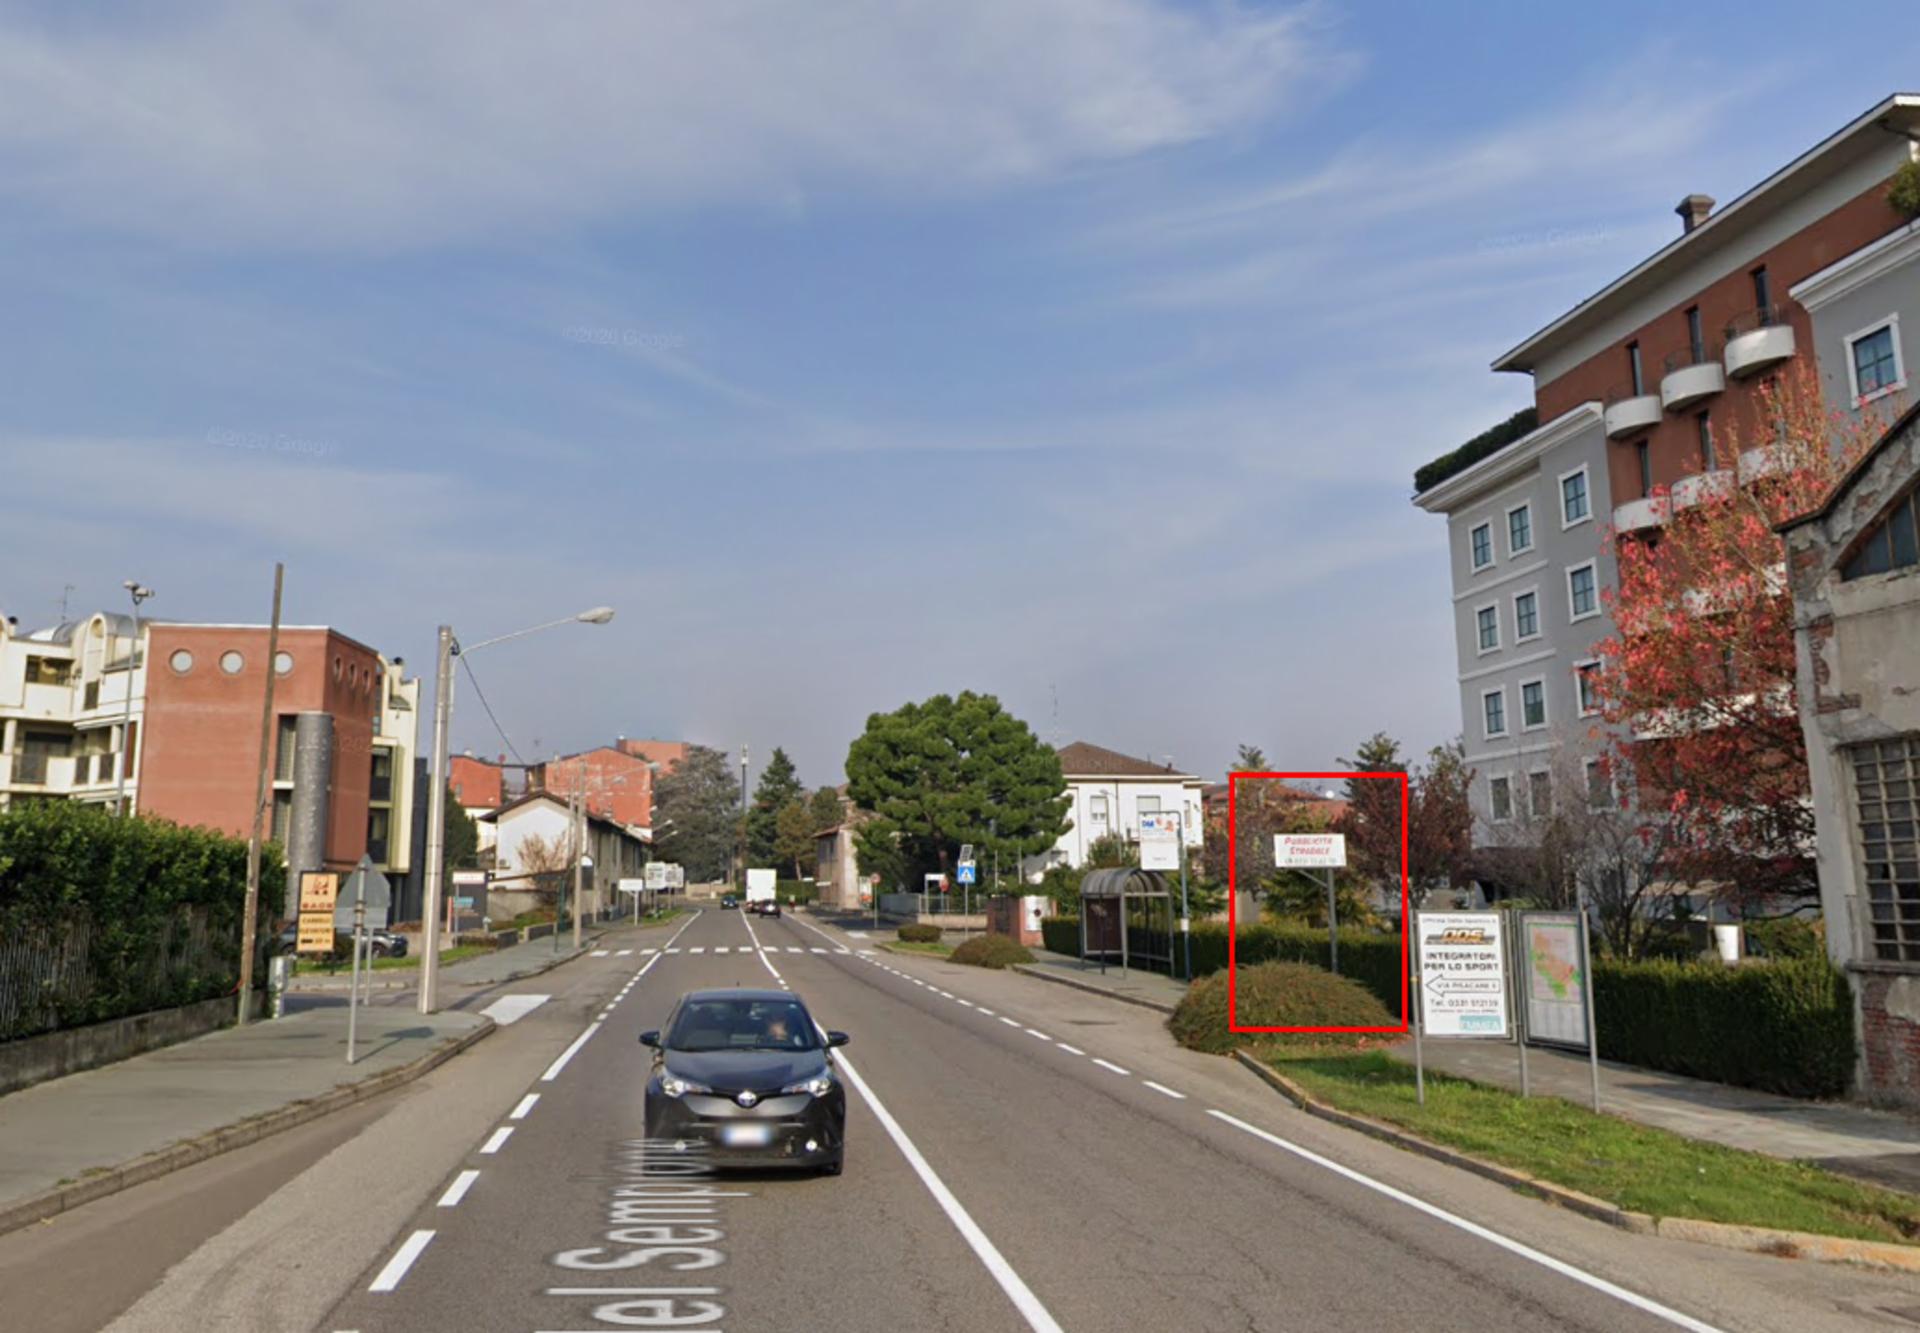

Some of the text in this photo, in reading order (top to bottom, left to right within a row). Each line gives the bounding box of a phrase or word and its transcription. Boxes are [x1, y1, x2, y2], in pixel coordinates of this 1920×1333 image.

[1426, 952, 1496, 960] INTEGRATORI
[1424, 962, 1499, 971] PER LO SPORT
